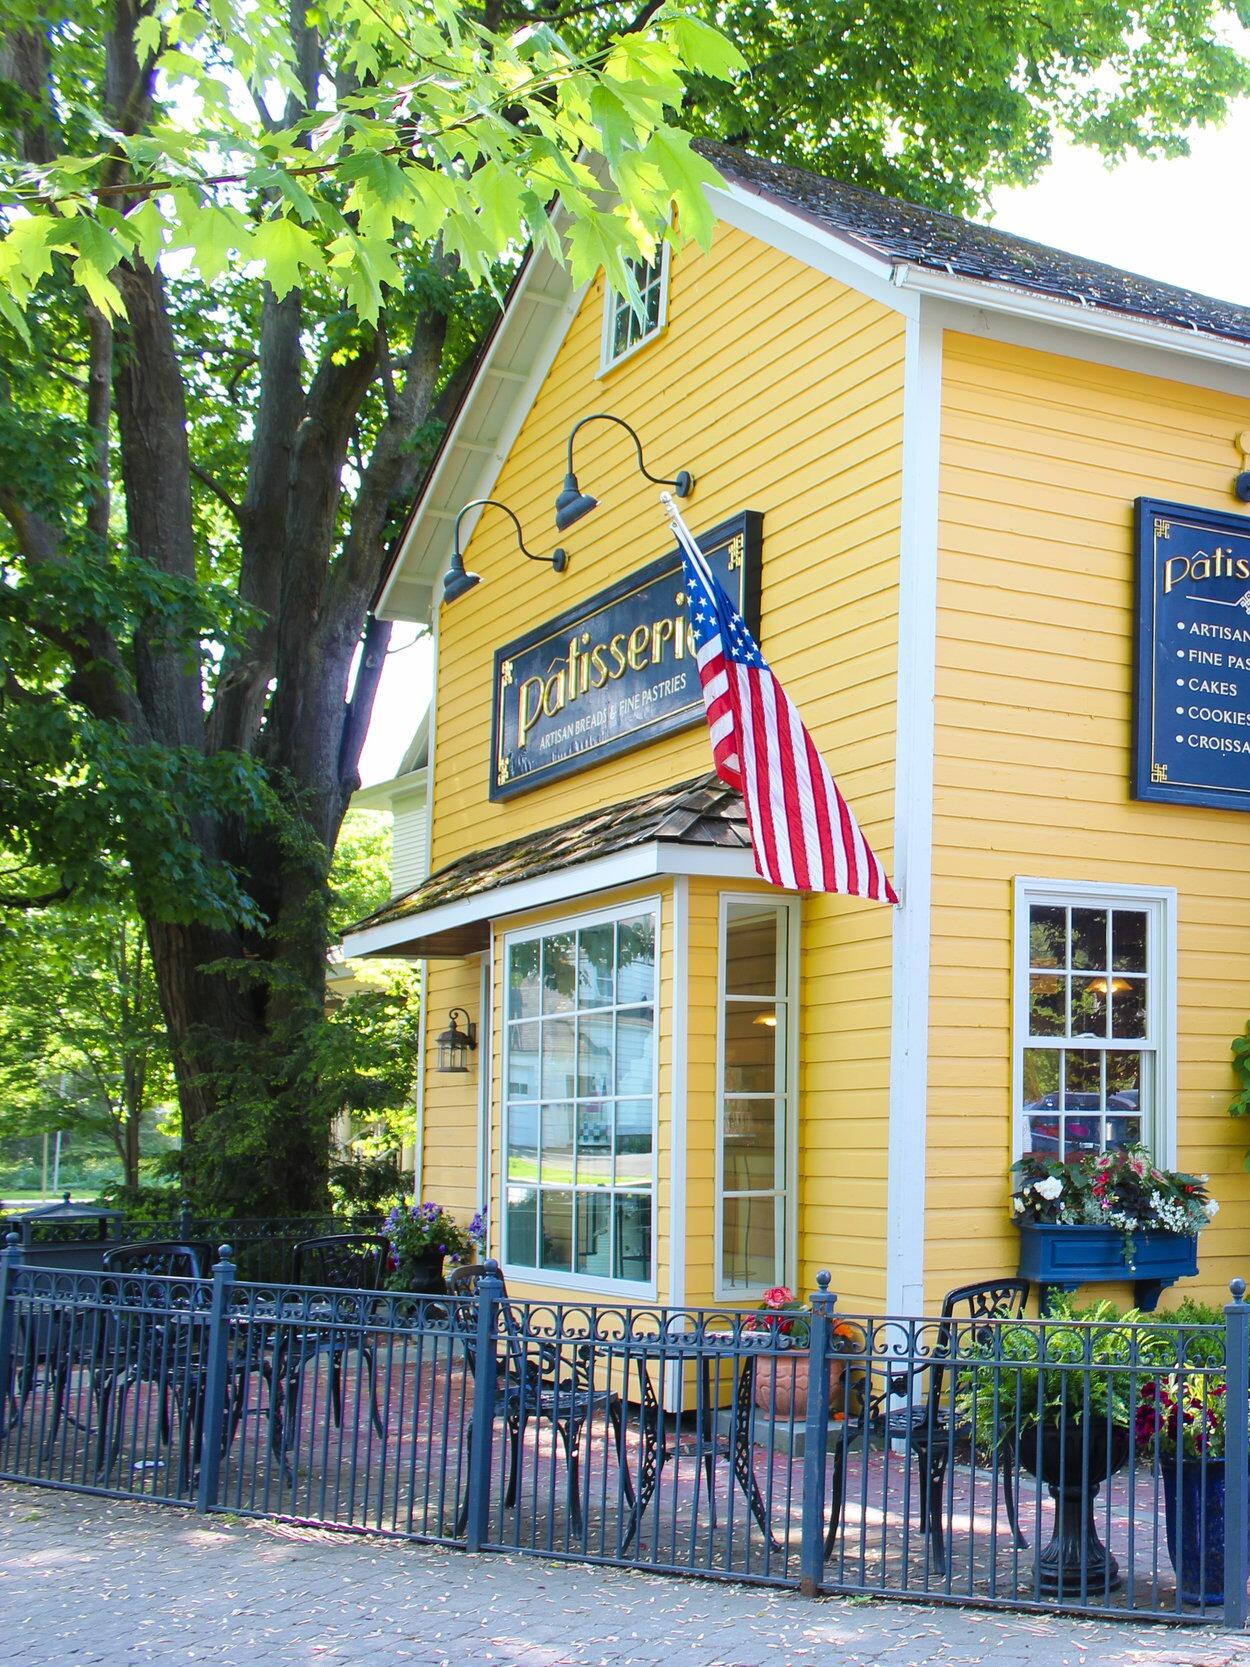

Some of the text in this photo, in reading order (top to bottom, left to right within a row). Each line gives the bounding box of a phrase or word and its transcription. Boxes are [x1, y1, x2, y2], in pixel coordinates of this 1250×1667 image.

[1188, 649, 1222, 667] FINE
[1188, 678, 1237, 697] CAKES
[539, 672, 687, 751] ARTISAN BREADS & FINE PASTRIES
